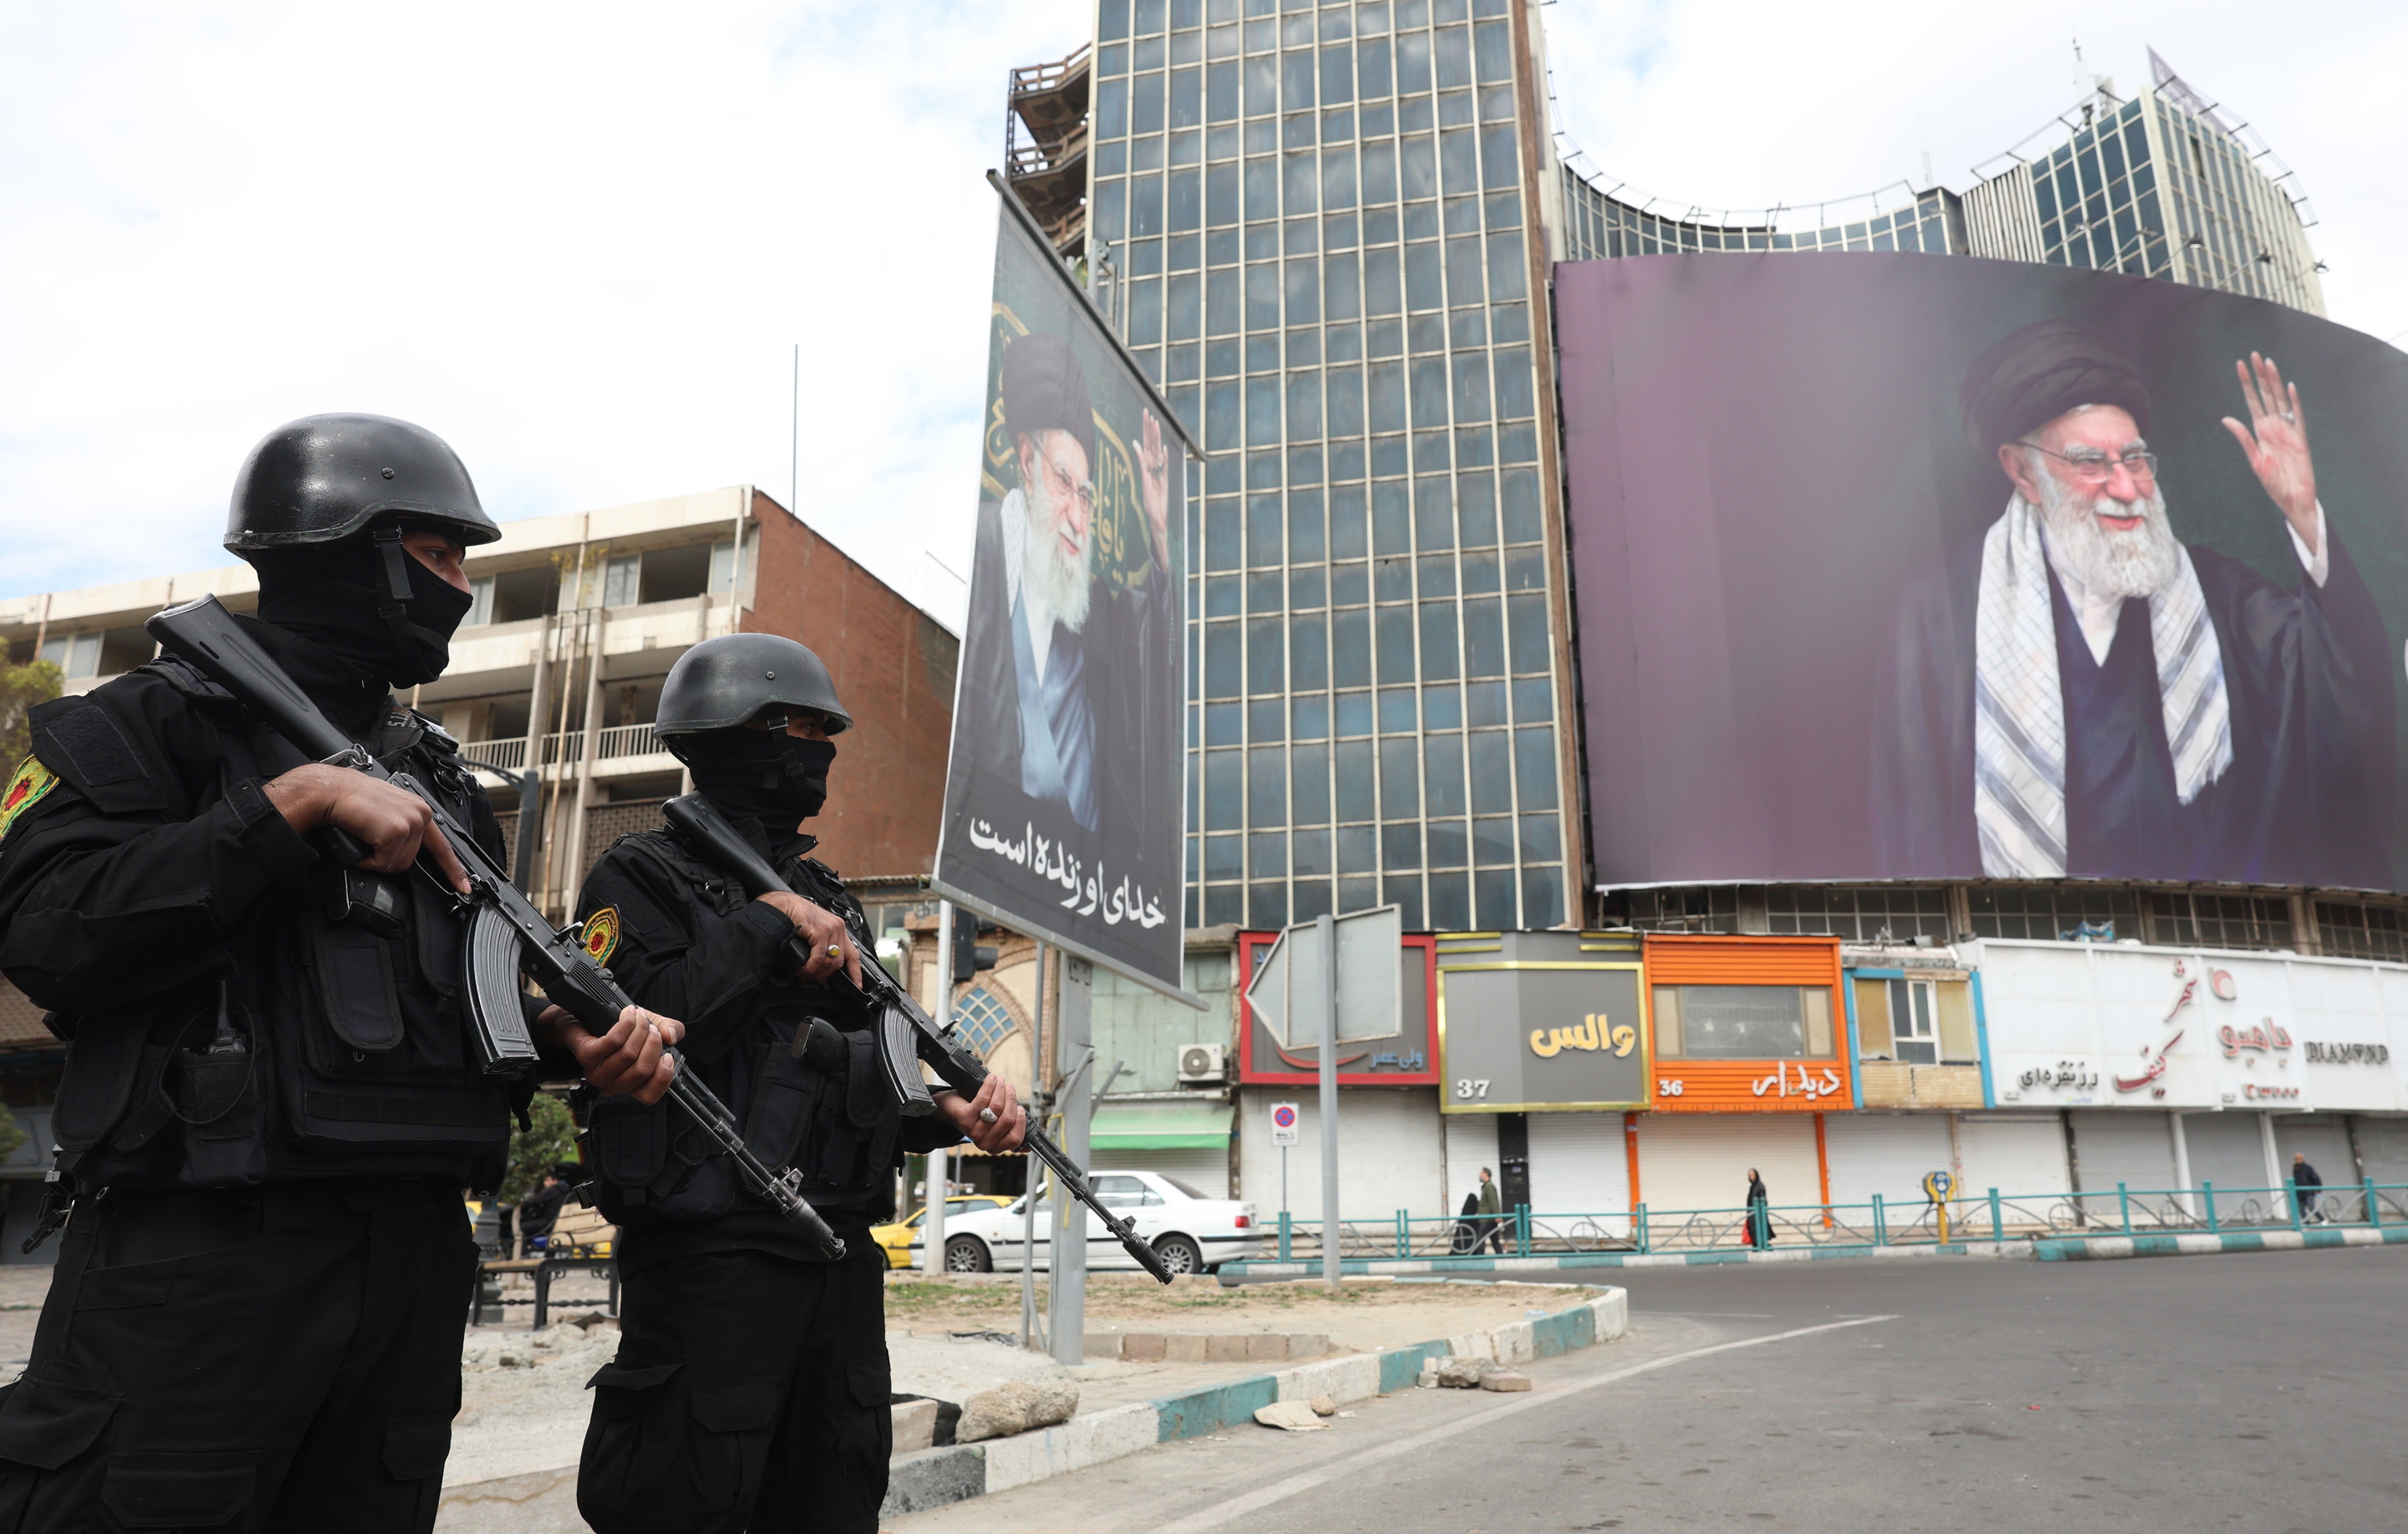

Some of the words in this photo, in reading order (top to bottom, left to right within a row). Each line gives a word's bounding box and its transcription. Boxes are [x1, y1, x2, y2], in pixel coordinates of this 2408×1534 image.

[969, 817, 1033, 869] است
[1034, 835, 1082, 909] زنده
[1076, 861, 1104, 917] او
[1103, 875, 1166, 929] خدای
[1529, 1013, 1636, 1058] والس
[1456, 1078, 1491, 1099] 37
[1659, 1079, 1684, 1097] 36
